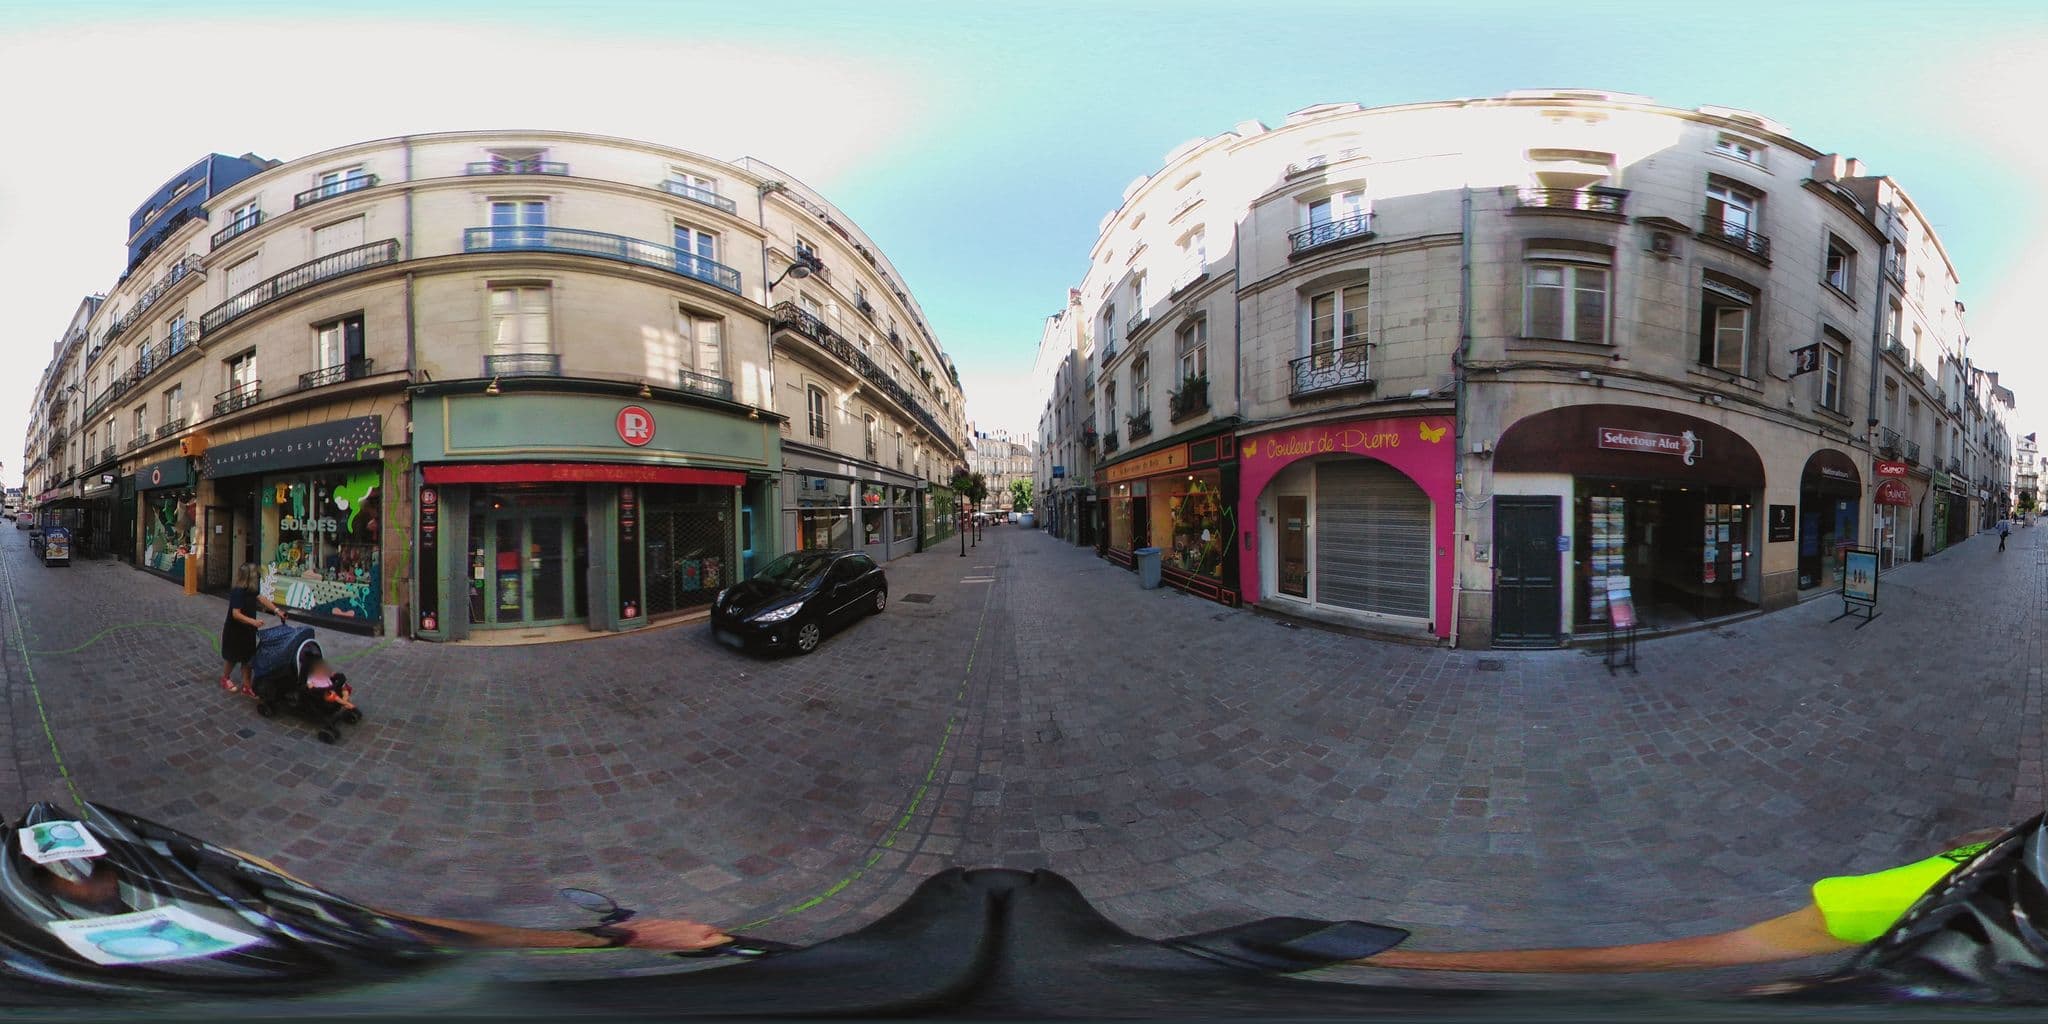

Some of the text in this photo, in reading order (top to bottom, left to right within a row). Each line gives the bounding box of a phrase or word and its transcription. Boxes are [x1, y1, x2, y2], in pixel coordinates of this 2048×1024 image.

[625, 413, 648, 438] R
[1266, 429, 1400, 459] Couleur de Pierre
[1604, 432, 1680, 450] Selectour Afat
[280, 518, 338, 532] SOLDES
